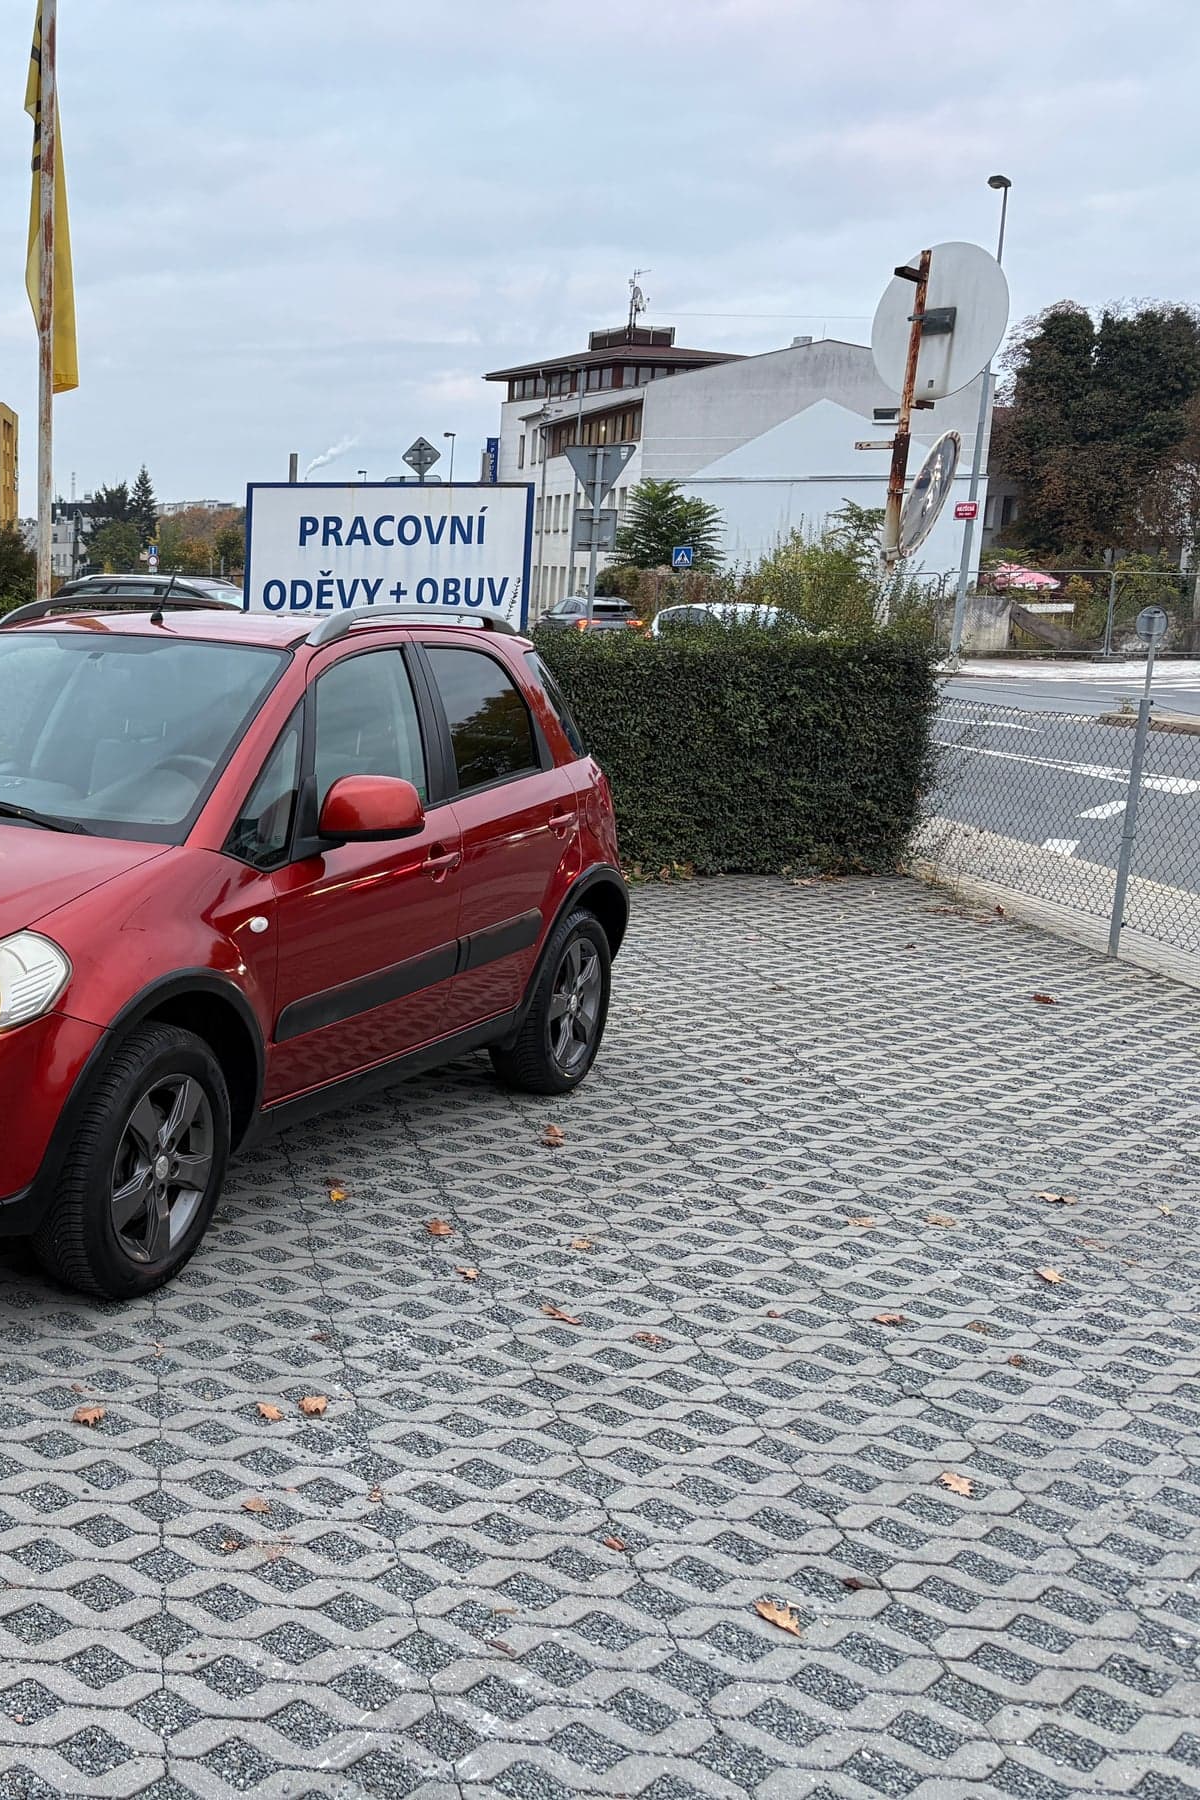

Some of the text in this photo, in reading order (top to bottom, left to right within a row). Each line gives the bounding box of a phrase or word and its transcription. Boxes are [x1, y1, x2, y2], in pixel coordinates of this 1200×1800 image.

[298, 506, 489, 547] PRACOVNÍ
[262, 569, 384, 610] ODĚVY
[415, 576, 509, 607] OBUV
